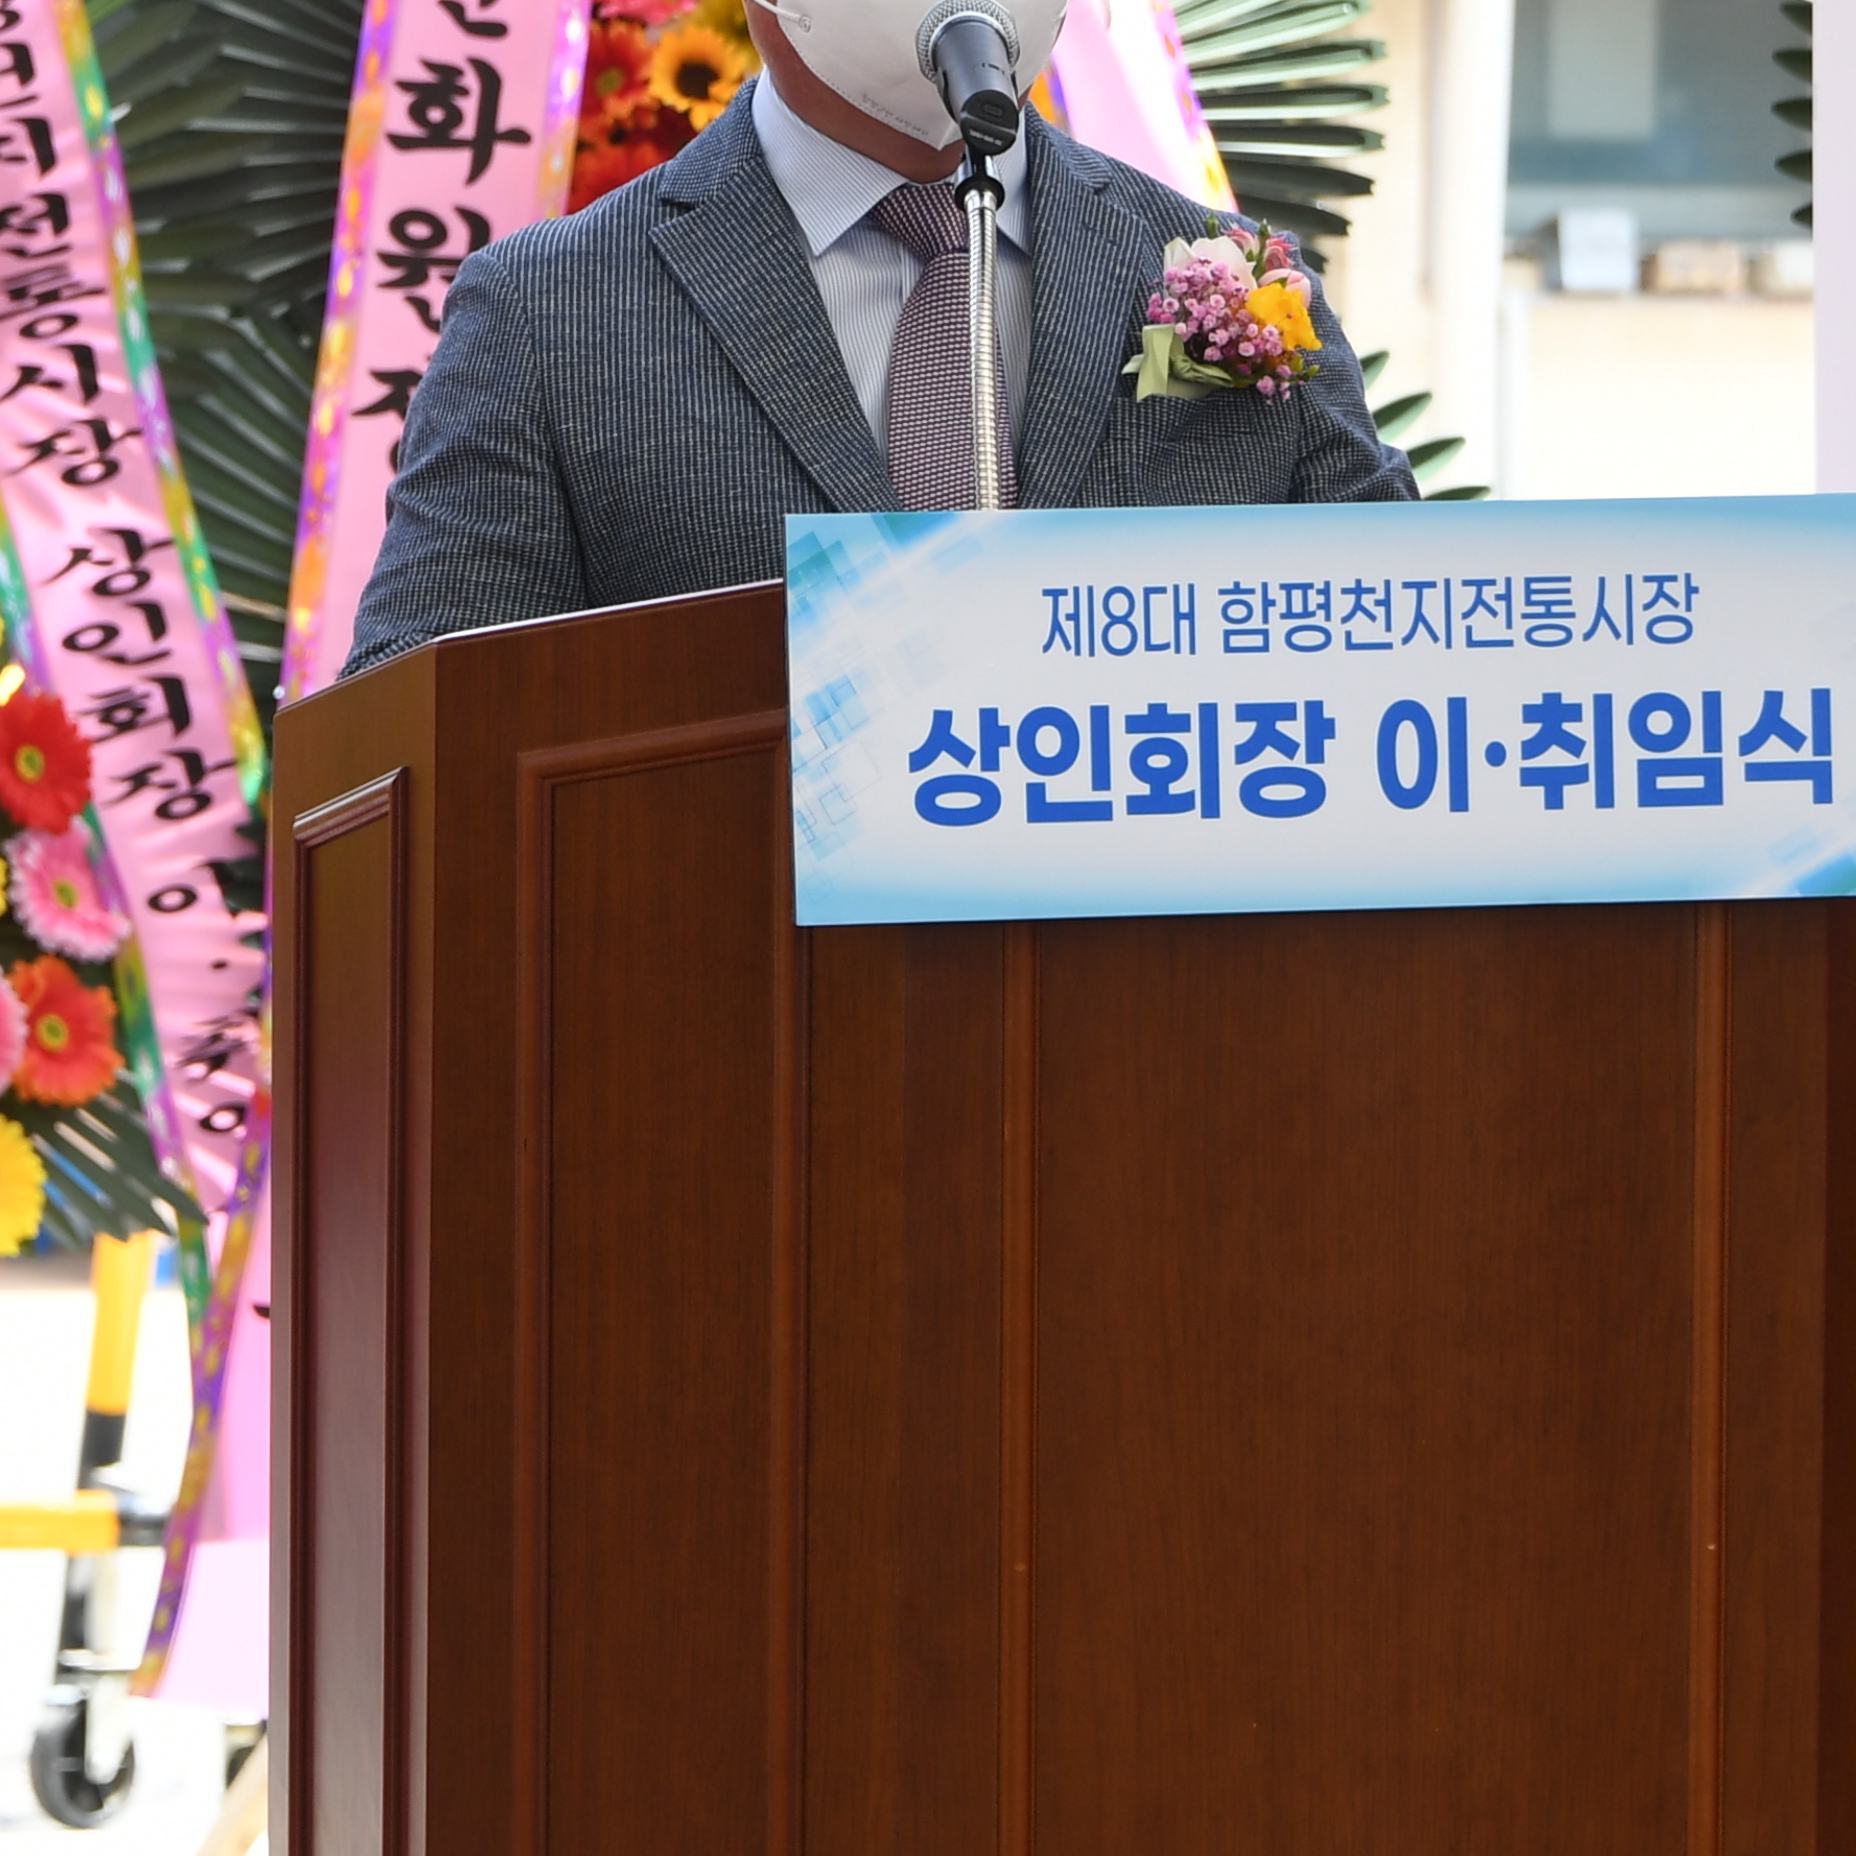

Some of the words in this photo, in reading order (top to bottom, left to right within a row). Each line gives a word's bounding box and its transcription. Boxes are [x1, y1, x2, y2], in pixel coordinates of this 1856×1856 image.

[39, 526, 238, 824] 상인회장
[1041, 582, 1198, 658] 제8대
[1218, 572, 1700, 655] 함평천지전통시장
[908, 699, 1337, 828] 상인회장
[1376, 687, 1834, 813] 이·취임식
